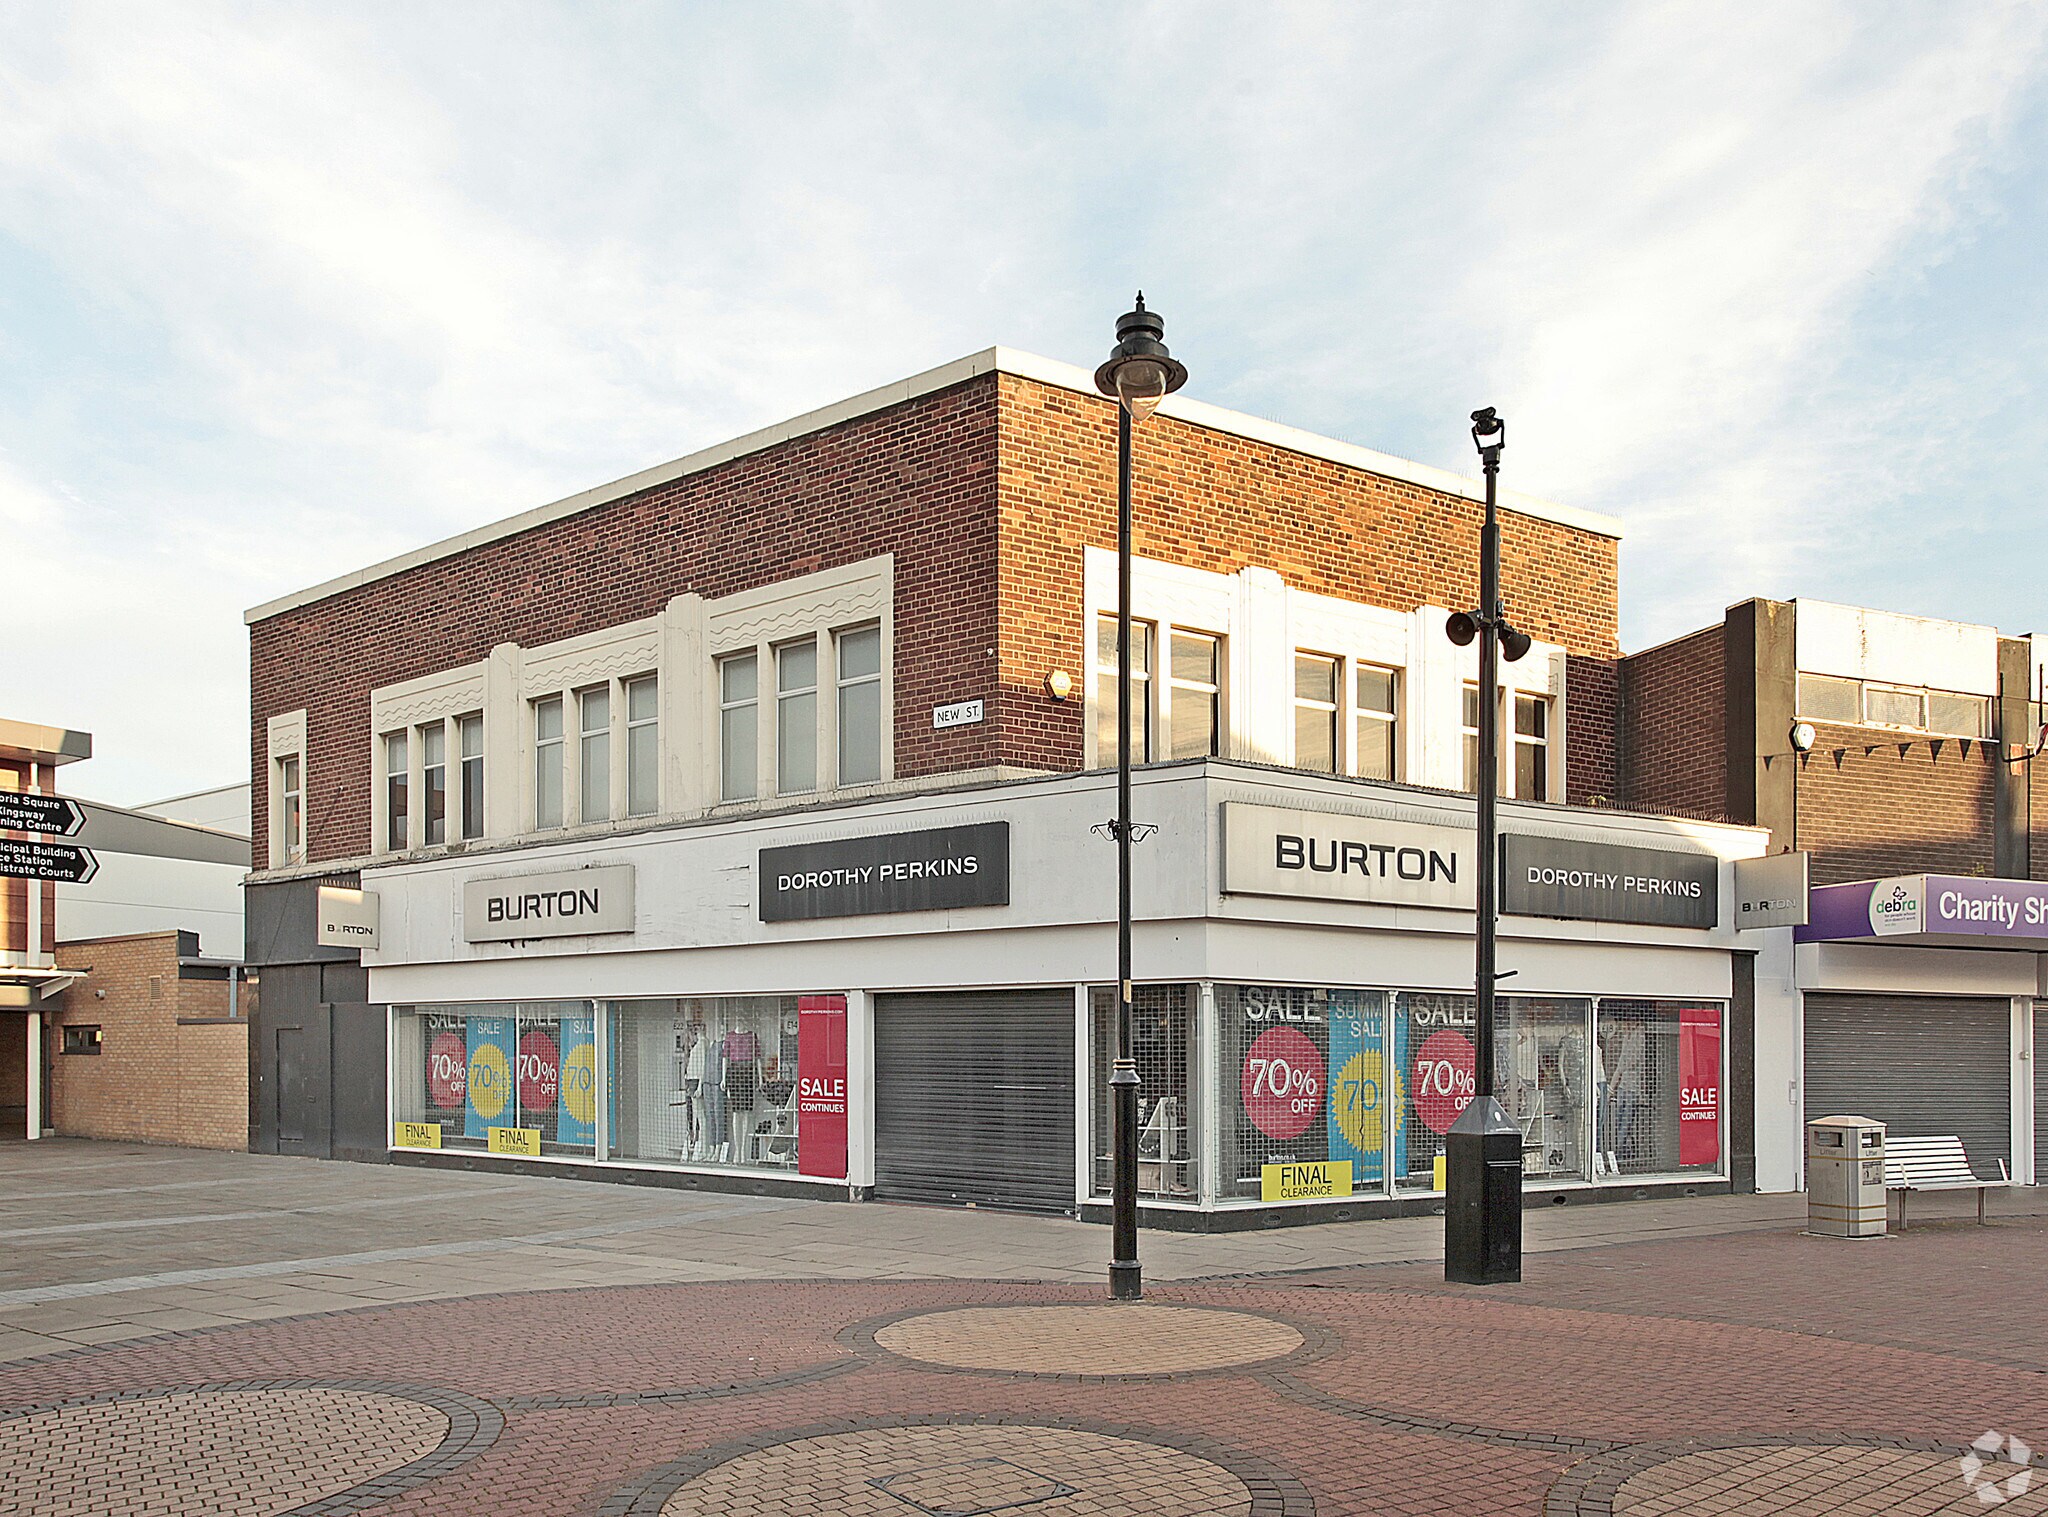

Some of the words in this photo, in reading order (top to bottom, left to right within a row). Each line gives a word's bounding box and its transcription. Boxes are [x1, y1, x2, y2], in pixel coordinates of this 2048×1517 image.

[937, 708, 960, 723] NEW
[966, 705, 979, 718] ST.
[23, 796, 60, 810] Square
[26, 819, 62, 832] Centre
[14, 854, 53, 866] Station
[33, 845, 76, 860] Building
[1276, 833, 1457, 884] BURTON
[39, 866, 75, 879] Courts
[778, 866, 873, 892] DOROTHY
[879, 856, 979, 882] PERKINS
[1527, 866, 1618, 890] DOROTHY
[1623, 876, 1701, 898] PERKINS
[488, 887, 599, 923] BURTON
[1876, 899, 1916, 913] debra
[1939, 891, 2019, 930] Charity
[327, 924, 373, 935] BRTON
[1246, 987, 1323, 1023] SALE
[1335, 1002, 1402, 1019] SUMM
[428, 1006, 466, 1029] SALE
[478, 1021, 499, 1035] SALE
[573, 1020, 594, 1033] SAL
[1350, 1020, 1382, 1038] SAL
[431, 1054, 466, 1080] 70%
[519, 1054, 557, 1082] 70%
[450, 1081, 466, 1092] OFF
[568, 1066, 594, 1091] 70
[1249, 1058, 1318, 1099] 70%
[1417, 1060, 1476, 1097] 70%
[540, 1083, 557, 1095] OFF
[801, 1078, 844, 1097] SALE
[1681, 1088, 1717, 1105] SALE
[801, 1103, 845, 1113] CONTINUES
[1290, 1098, 1316, 1114] OFF
[1681, 1111, 1717, 1120] CONTINUES
[405, 1124, 431, 1139] FINAL
[500, 1129, 529, 1146] FINAL
[405, 1138, 432, 1147] CLEARANCE
[500, 1144, 529, 1154] CLEARANCE
[1281, 1165, 1332, 1187] FINAL
[1281, 1186, 1333, 1198] CLEARANCE
